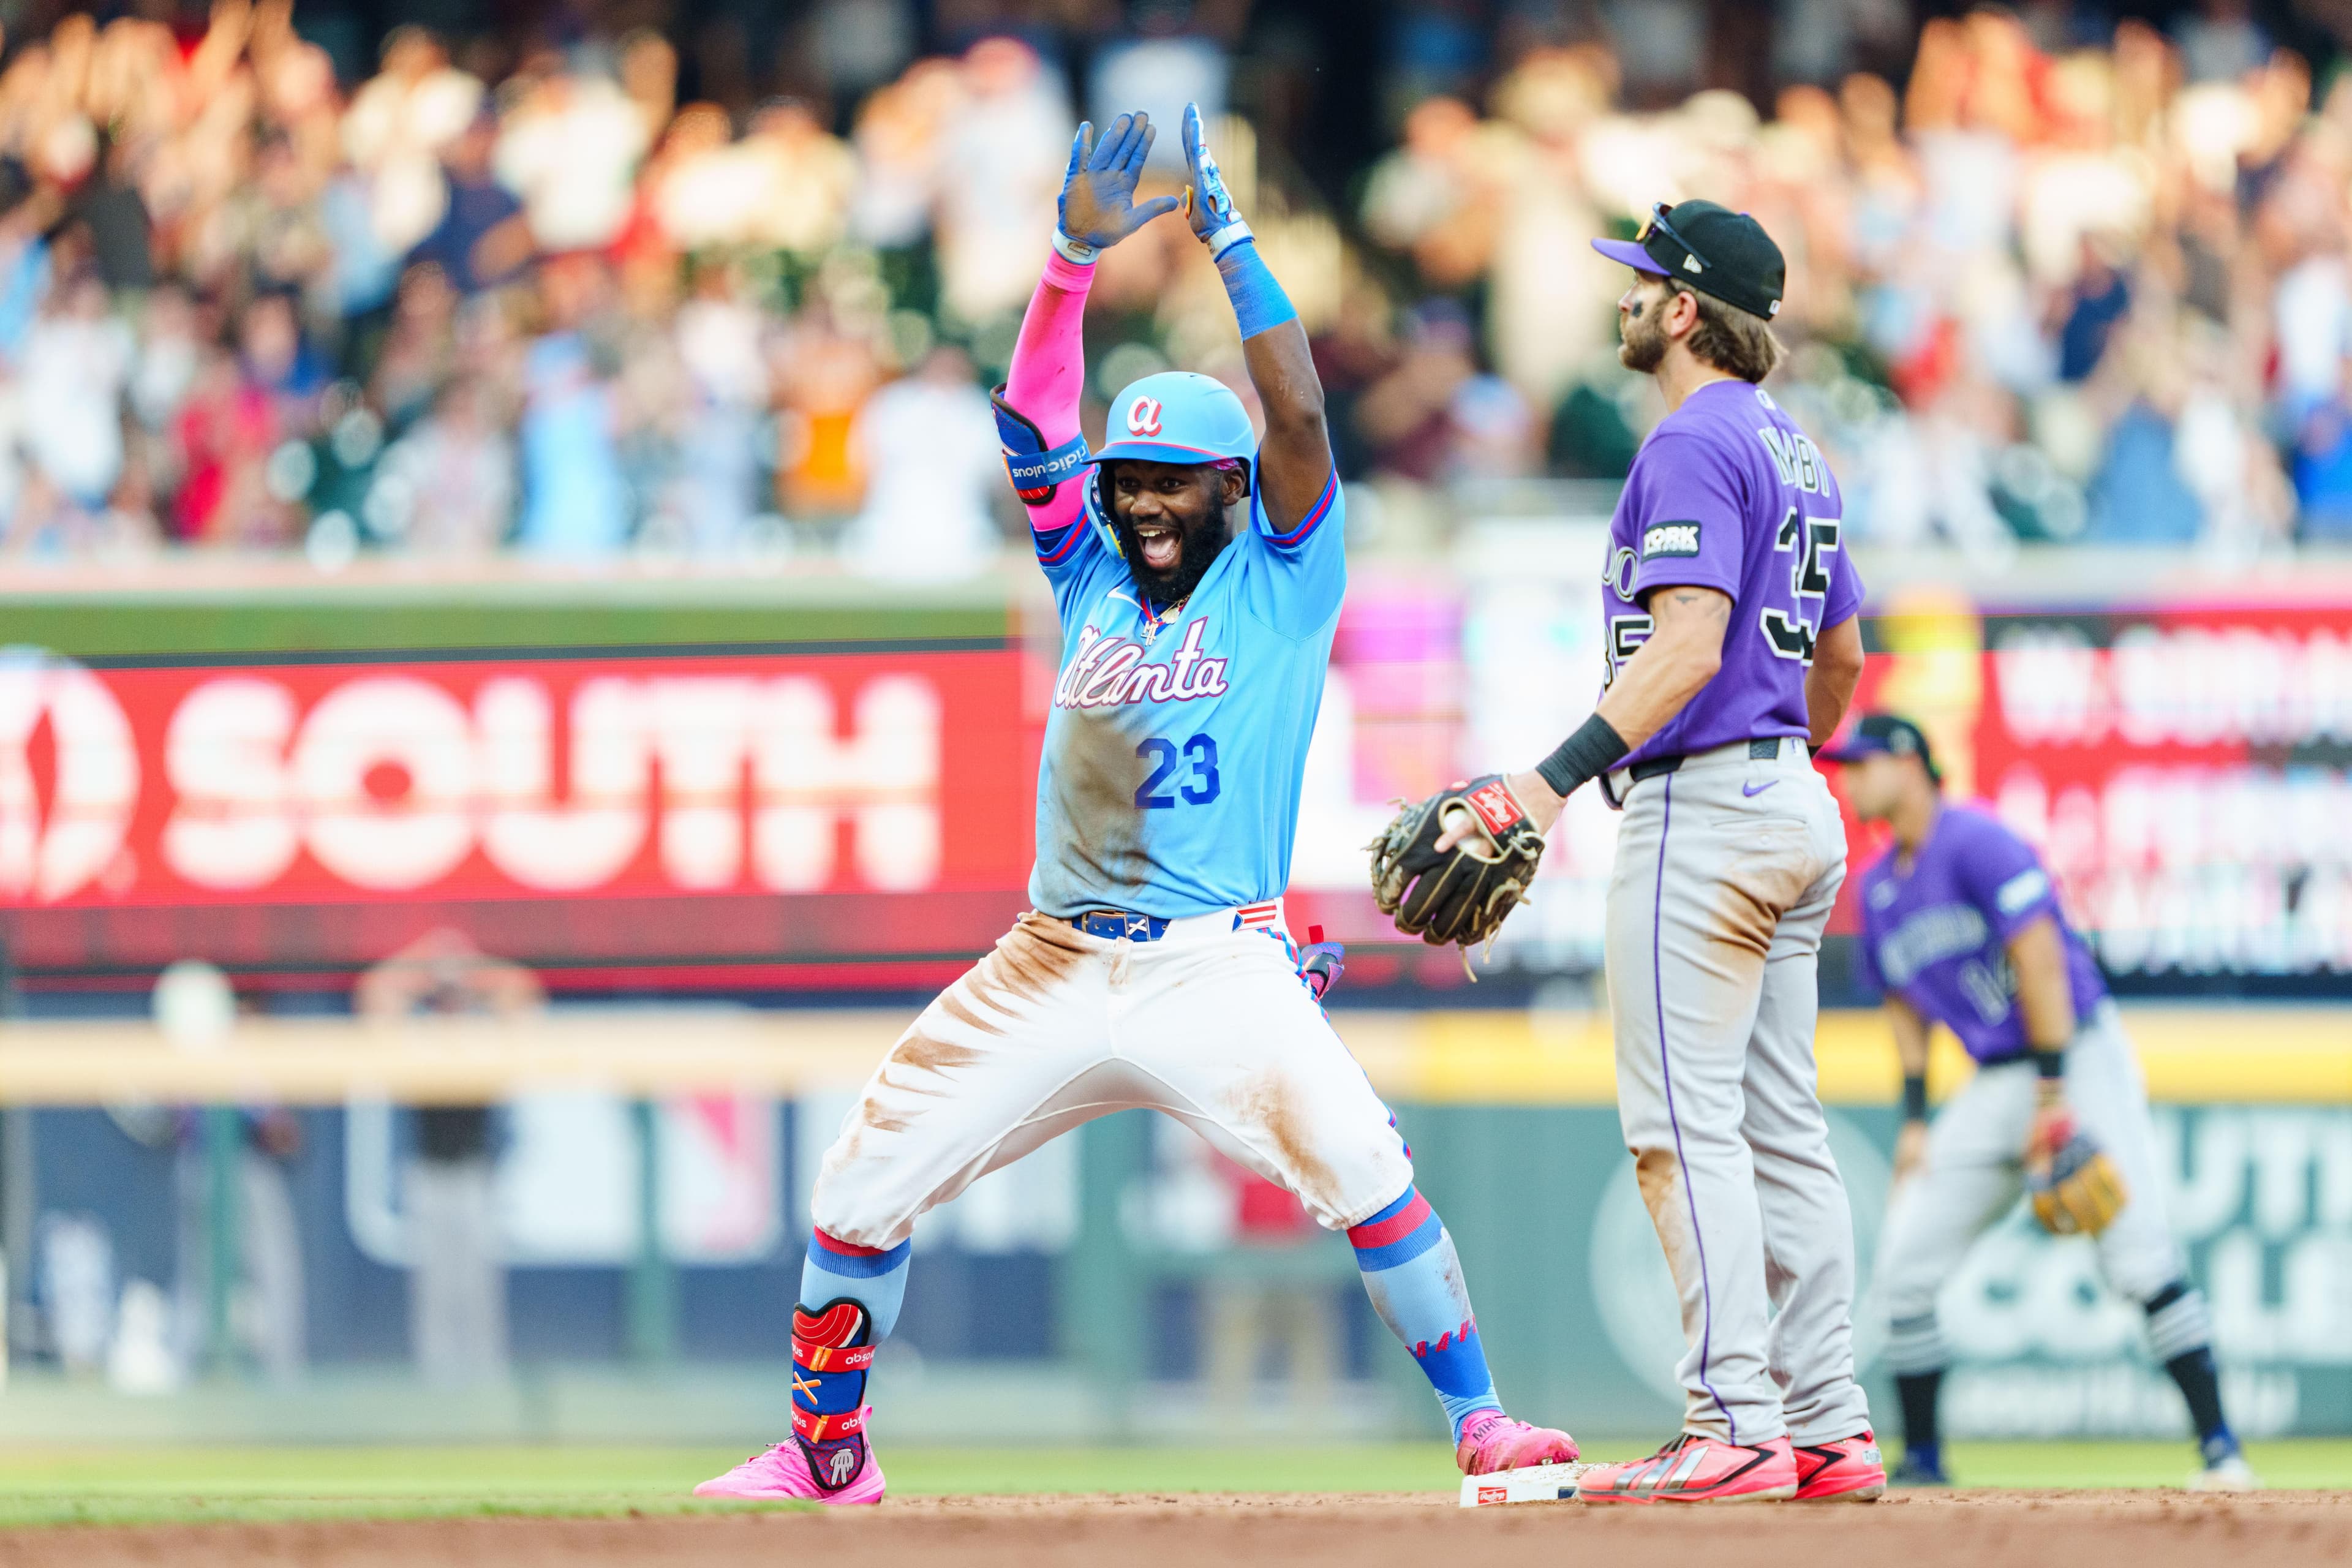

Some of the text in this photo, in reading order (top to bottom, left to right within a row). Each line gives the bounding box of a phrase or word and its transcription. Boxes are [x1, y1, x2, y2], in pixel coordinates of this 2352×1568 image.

[1012, 445, 1087, 478] ridiculous
[1759, 506, 1840, 666] 35
[1055, 616, 1229, 709] Atlanta
[164, 673, 943, 892] SOUTH
[1134, 733, 1220, 809] 23
